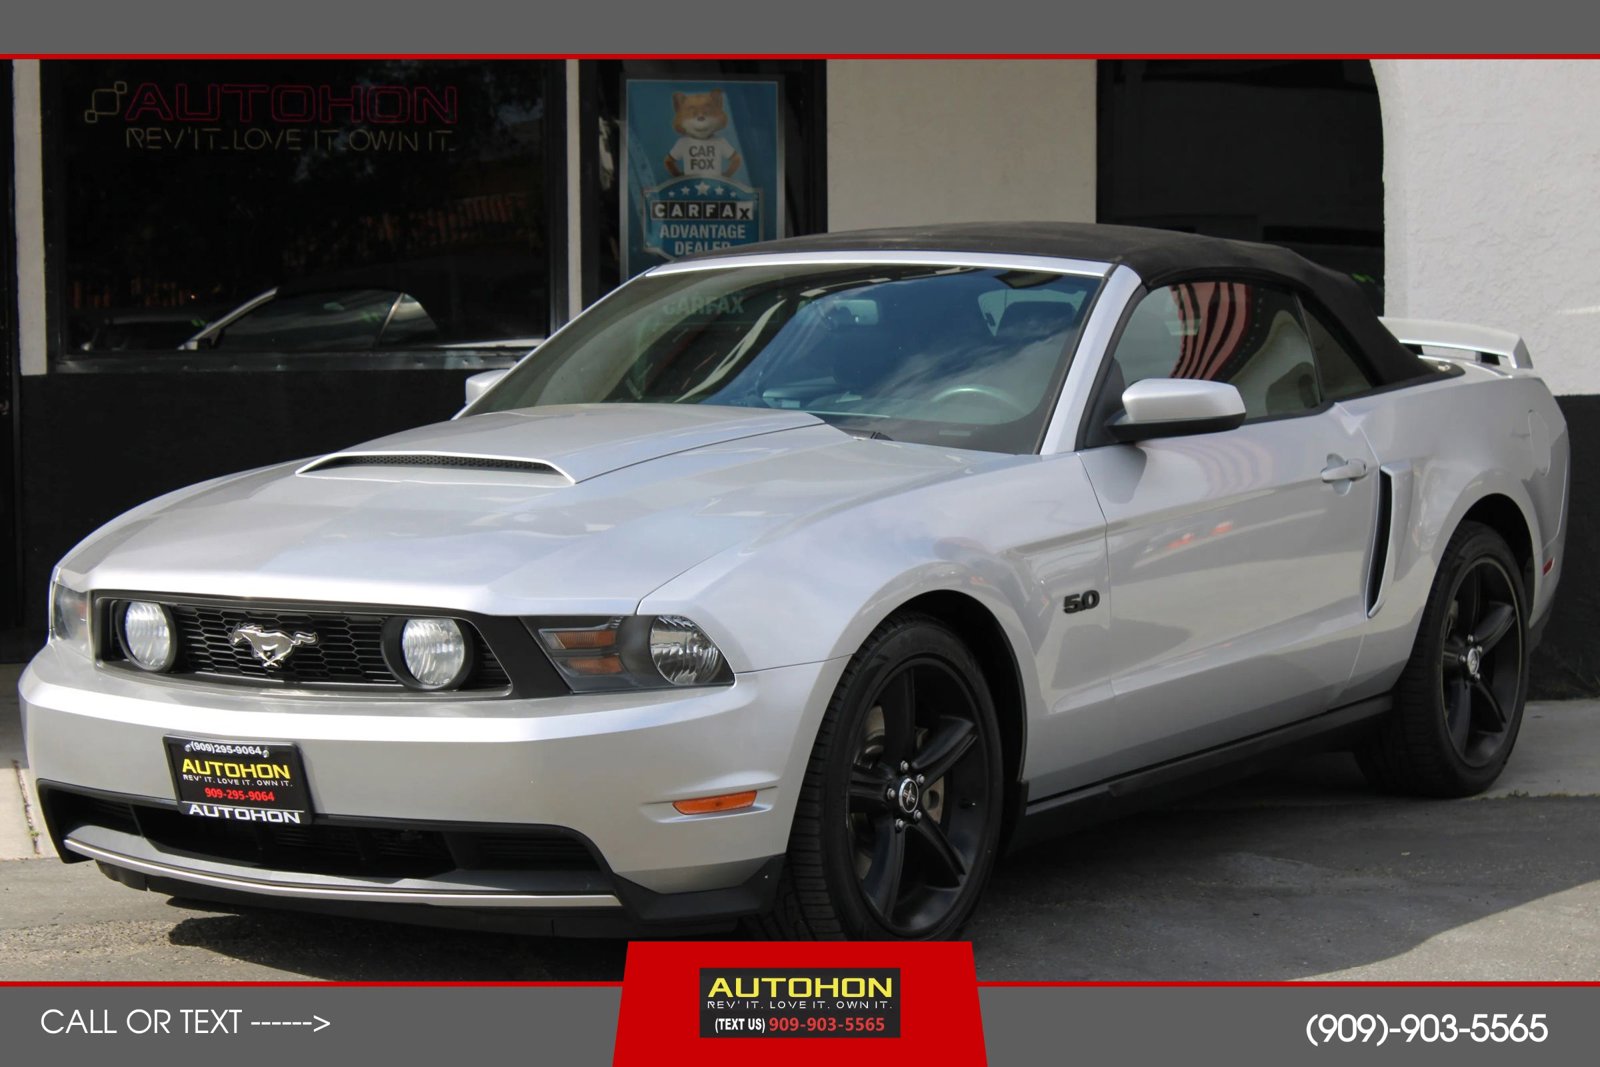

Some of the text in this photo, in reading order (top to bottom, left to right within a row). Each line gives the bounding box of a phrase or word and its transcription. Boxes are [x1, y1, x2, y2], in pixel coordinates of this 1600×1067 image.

[125, 82, 458, 124] AUTOHON
[233, 128, 302, 150] LOVE
[349, 128, 419, 152] OWN
[689, 145, 716, 158] CAR
[690, 158, 715, 171] FOX
[653, 202, 752, 220] CARFAX
[659, 224, 746, 239] ADVANTAGE
[191, 741, 262, 755] (909)295-9064
[182, 758, 291, 779] AUTOHON
[217, 777, 240, 786] LOVE
[256, 779, 279, 787] OWN
[204, 787, 275, 802] 909-295-9064
[189, 804, 301, 824] AUTOHON
